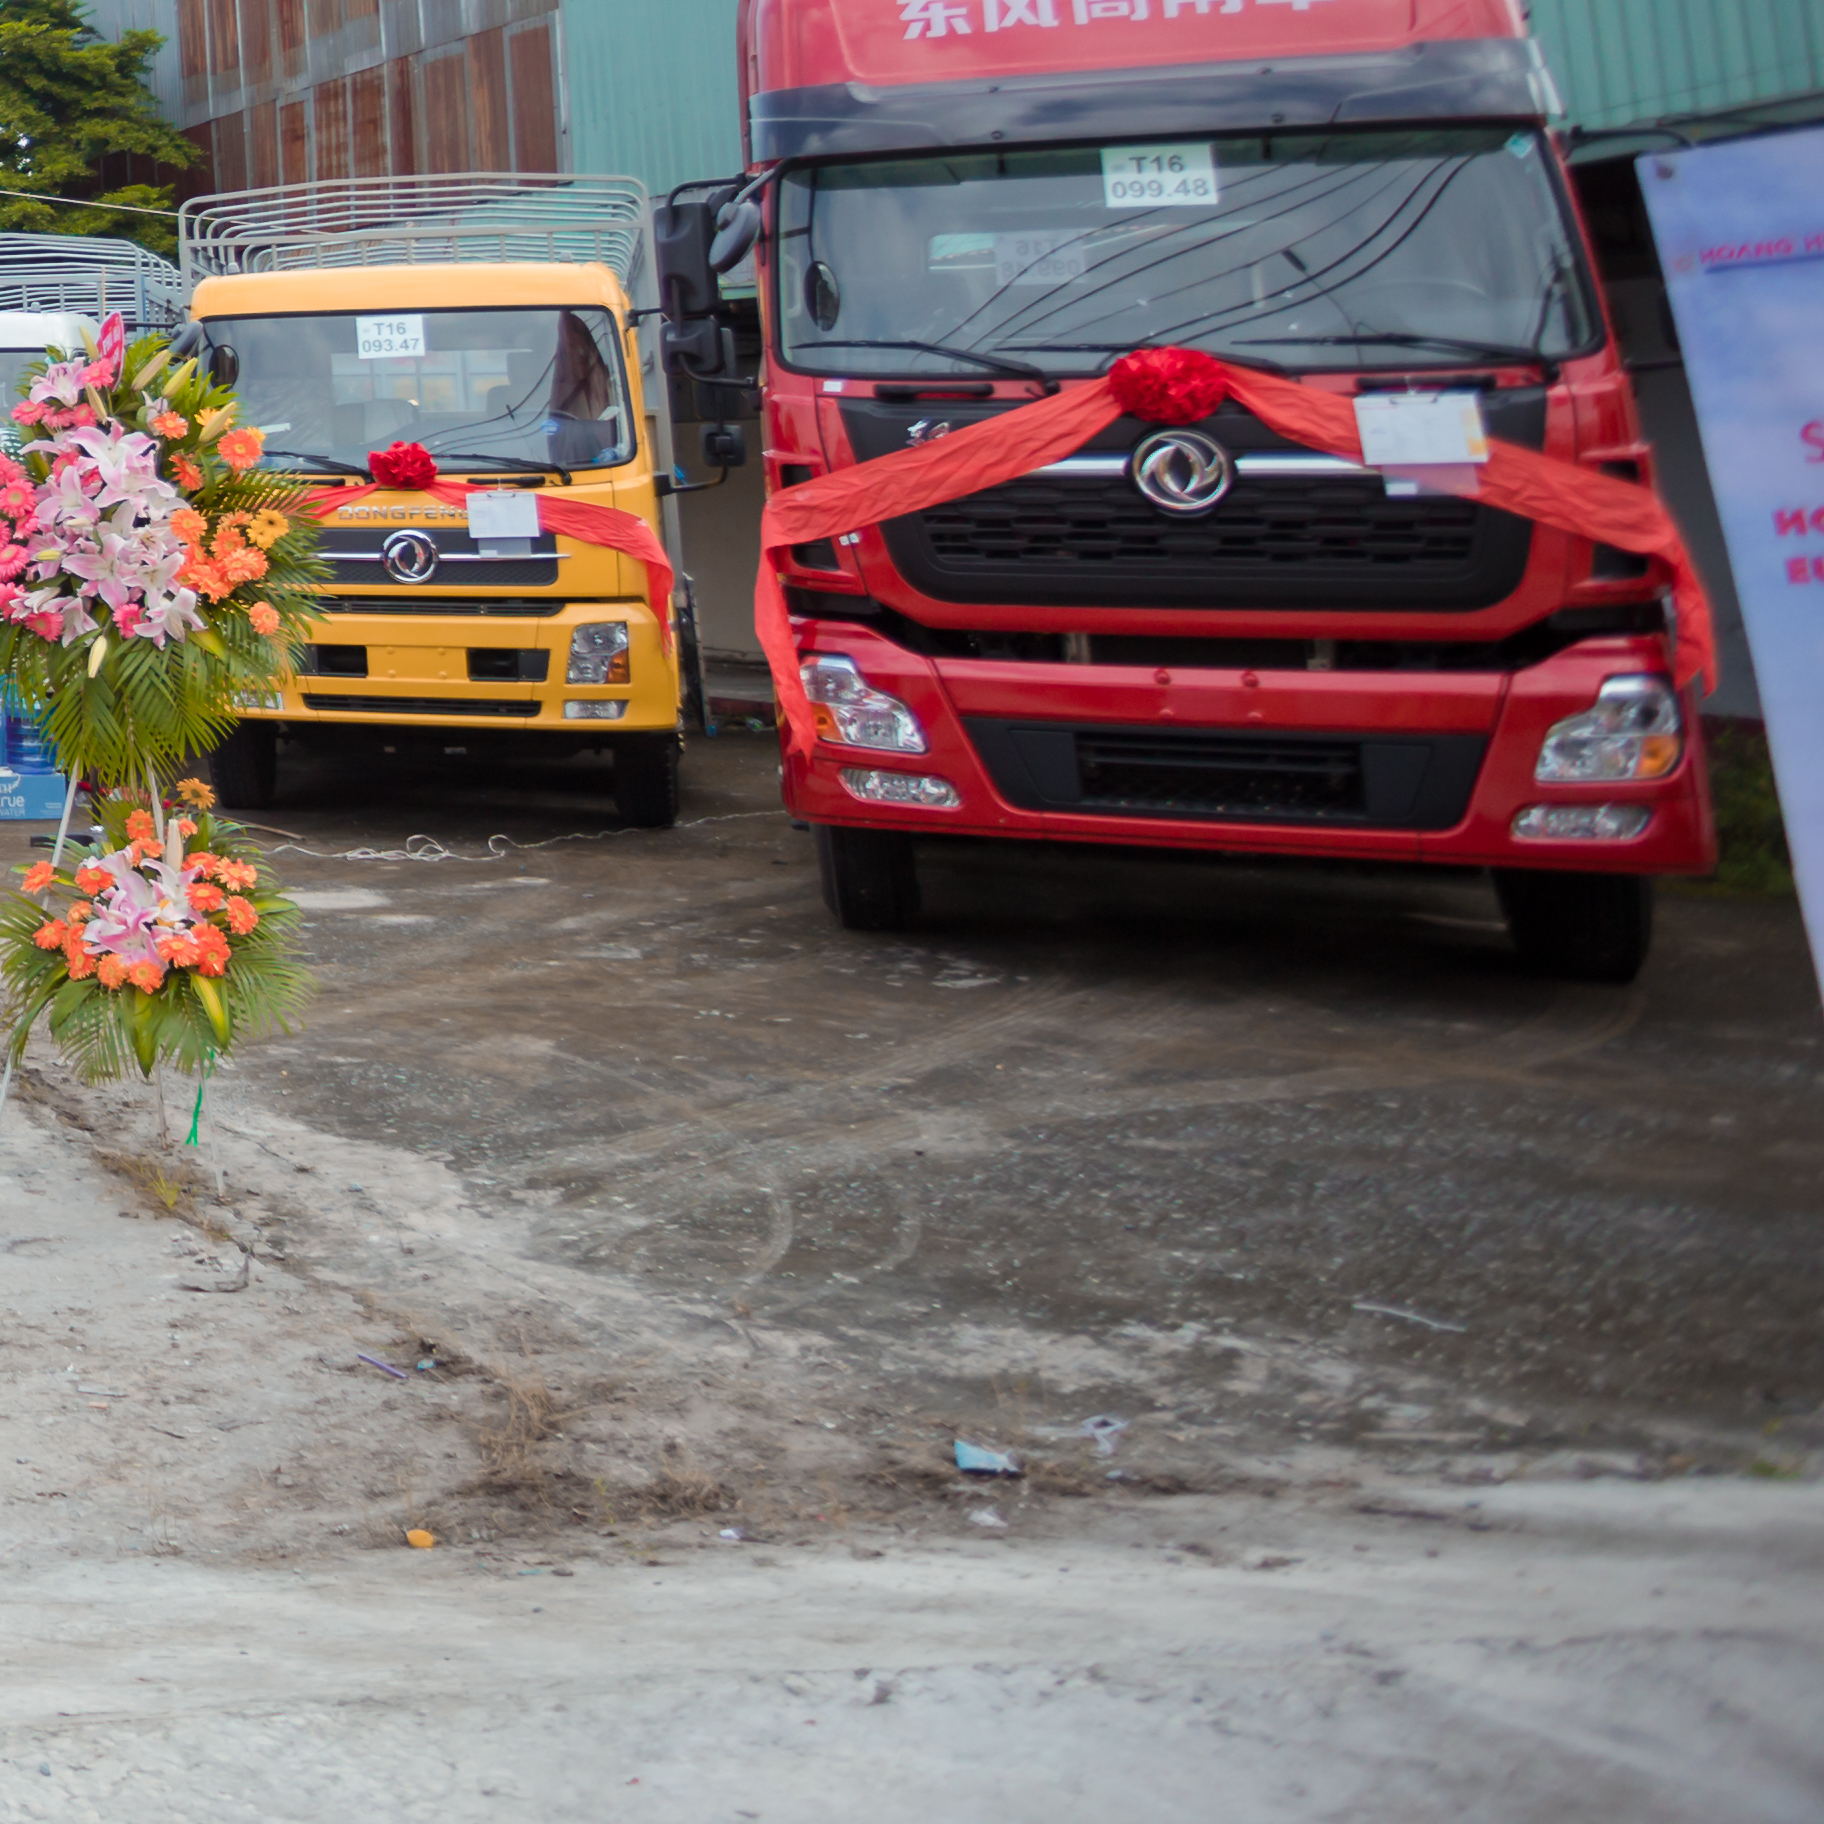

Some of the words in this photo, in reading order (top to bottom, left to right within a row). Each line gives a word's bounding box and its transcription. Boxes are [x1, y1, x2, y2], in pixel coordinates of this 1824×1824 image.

[1129, 154, 1185, 174] T16
[1111, 178, 1209, 199] 099.48
[373, 322, 406, 336] T16
[361, 338, 420, 353] 093.47
